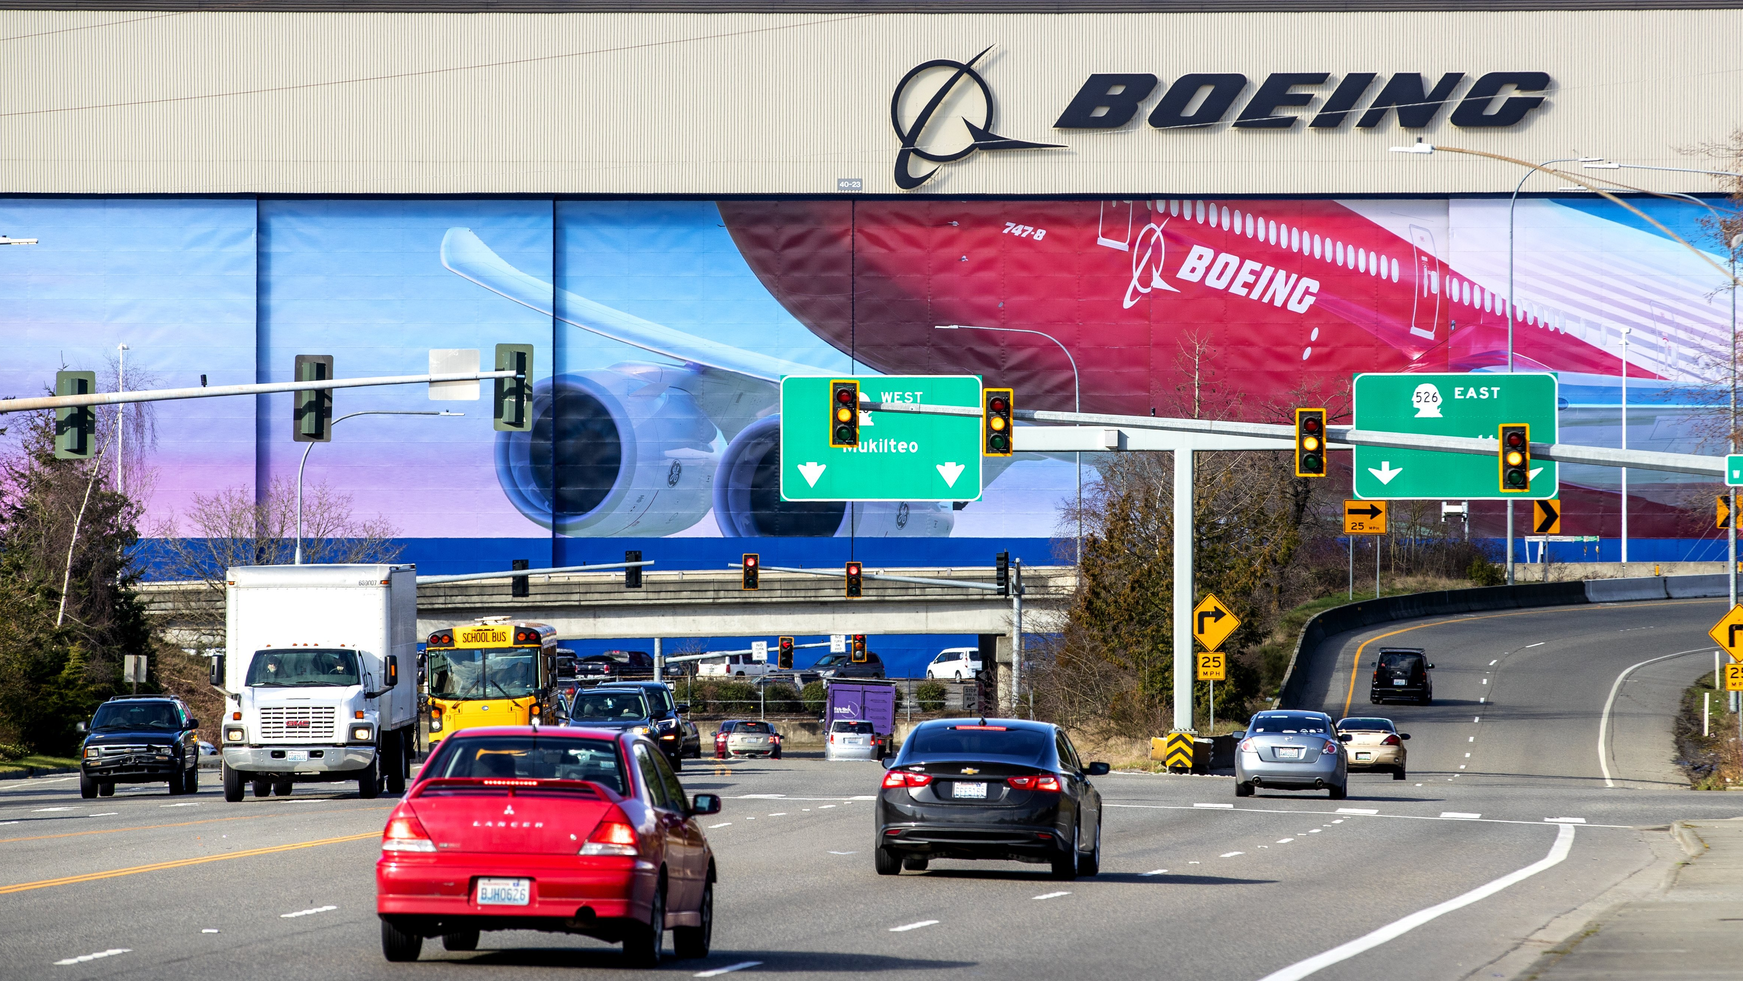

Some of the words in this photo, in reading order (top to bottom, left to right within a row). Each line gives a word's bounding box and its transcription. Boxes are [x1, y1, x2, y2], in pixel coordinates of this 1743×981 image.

[1052, 71, 1552, 129] BOEING
[1002, 221, 1047, 241] 747-8
[1176, 244, 1320, 314] BOEING
[881, 391, 923, 403] WEST
[1415, 391, 1438, 403] 526
[1454, 387, 1500, 399] EAST
[1351, 522, 1364, 530] 25
[462, 633, 489, 643] SCHOOL
[492, 632, 506, 642] BUS
[1202, 656, 1221, 668] 25
[481, 887, 526, 901] BJH0626
